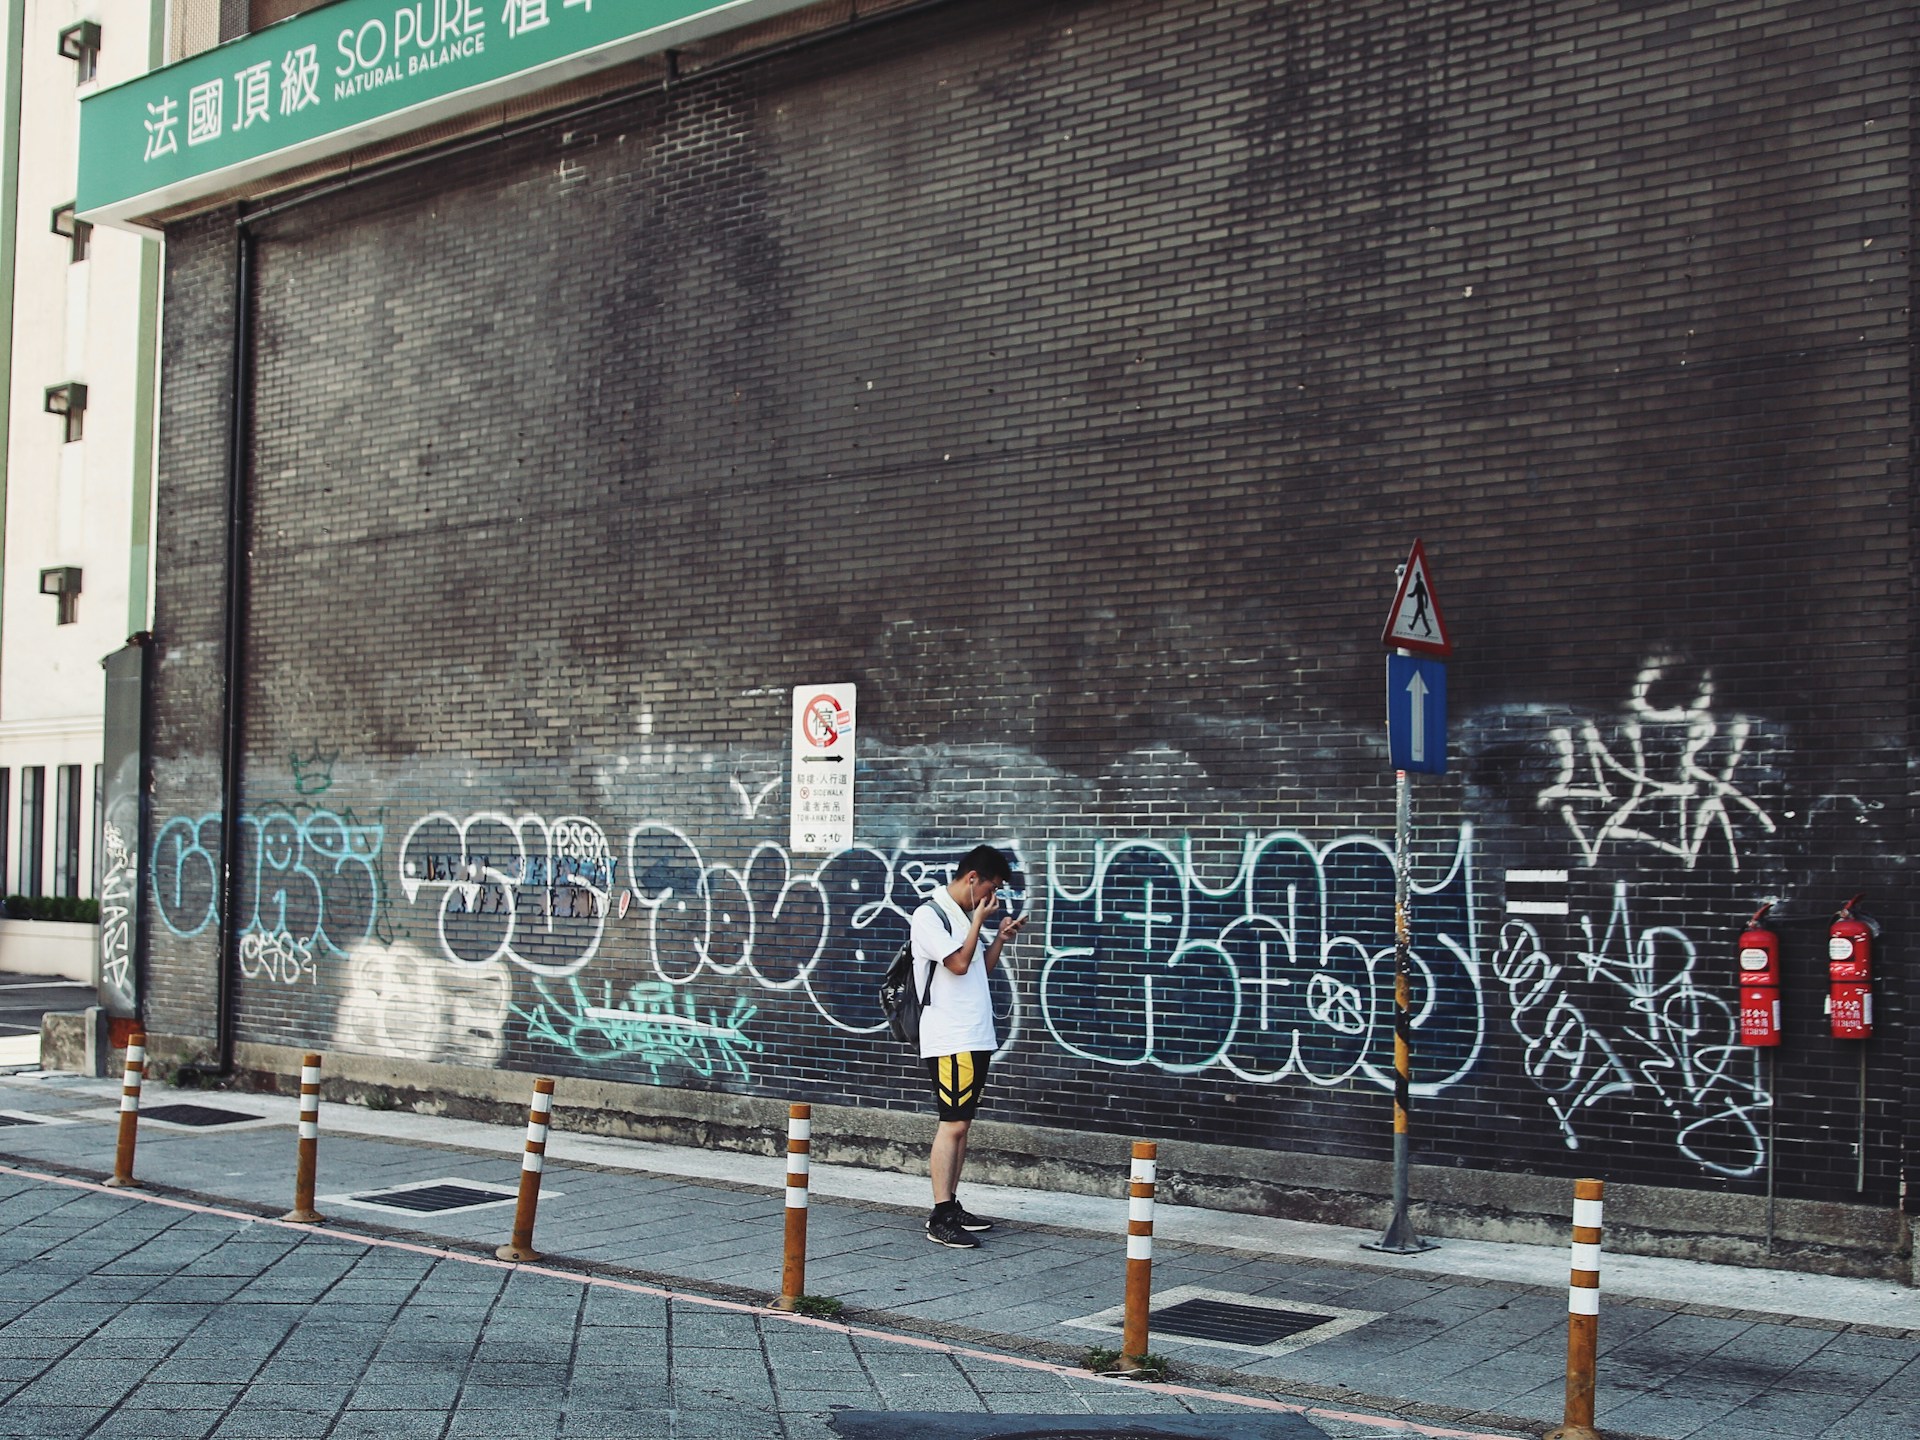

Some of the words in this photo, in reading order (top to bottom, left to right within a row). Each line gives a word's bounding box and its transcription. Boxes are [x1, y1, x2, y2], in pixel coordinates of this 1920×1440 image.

[334, 61, 404, 101] NATURAL
[408, 32, 485, 76] BALANCE
[336, 19, 387, 77] SO
[394, 0, 485, 58] PURE
[144, 44, 320, 162] 法國頂級
